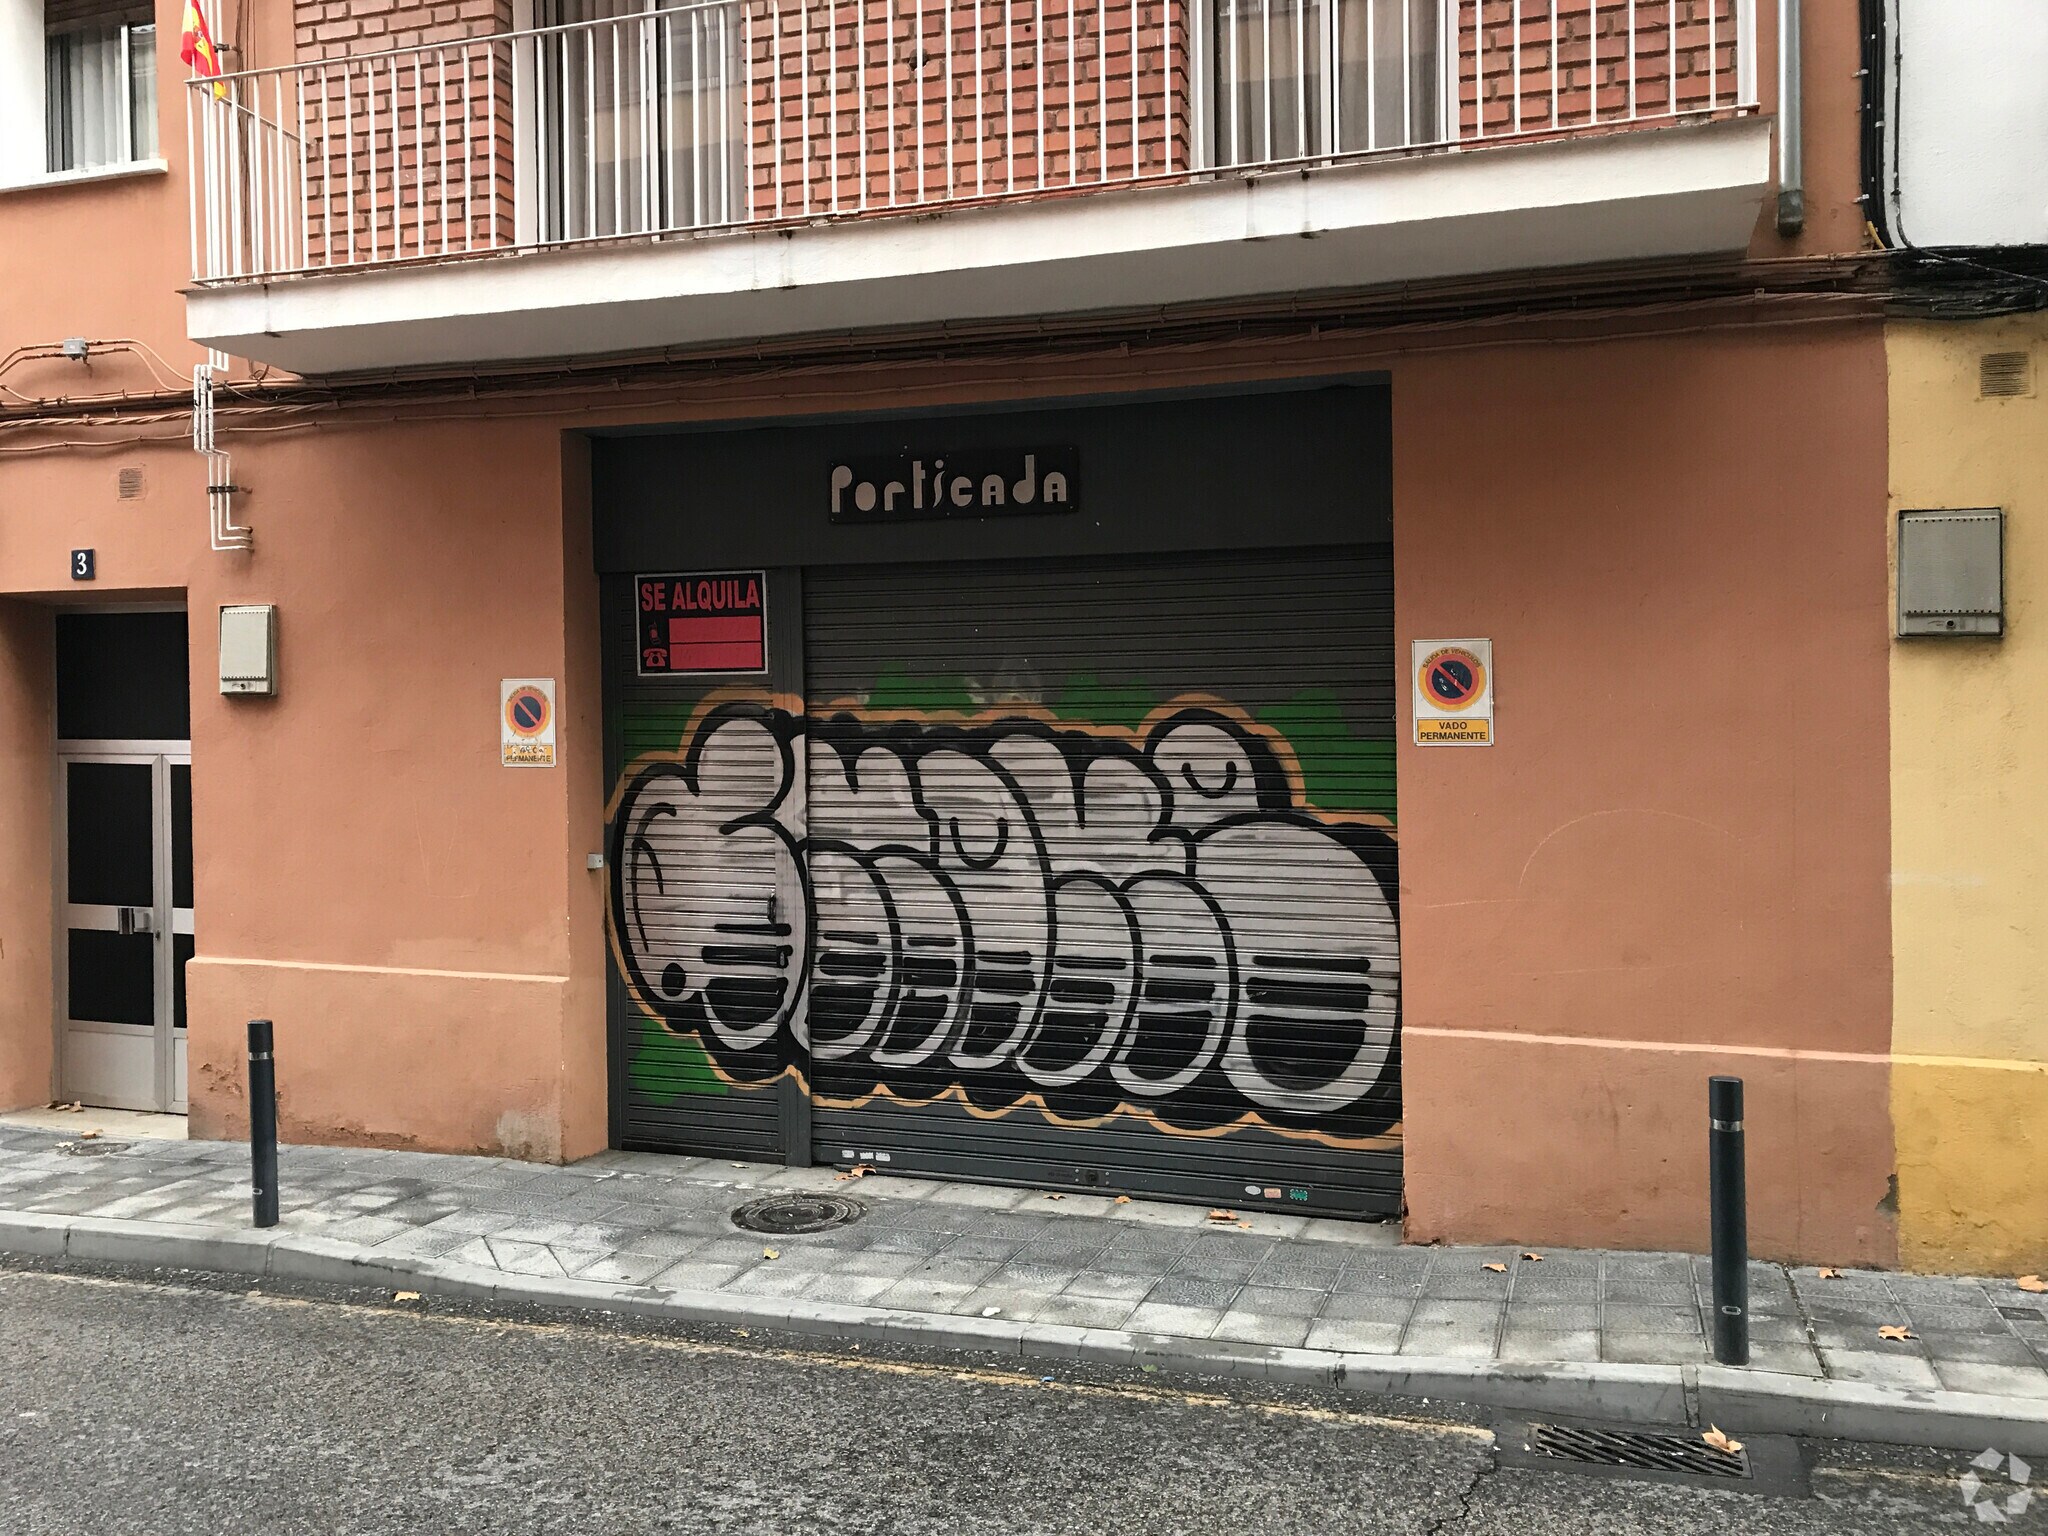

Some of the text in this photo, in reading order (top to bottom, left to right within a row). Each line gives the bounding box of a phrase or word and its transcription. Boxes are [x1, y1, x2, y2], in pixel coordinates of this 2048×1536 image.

[76, 552, 87, 575] 3
[641, 579, 760, 611] SE ALQUILA
[1439, 722, 1467, 730] VADO
[1420, 732, 1486, 740] PERMANENTE
